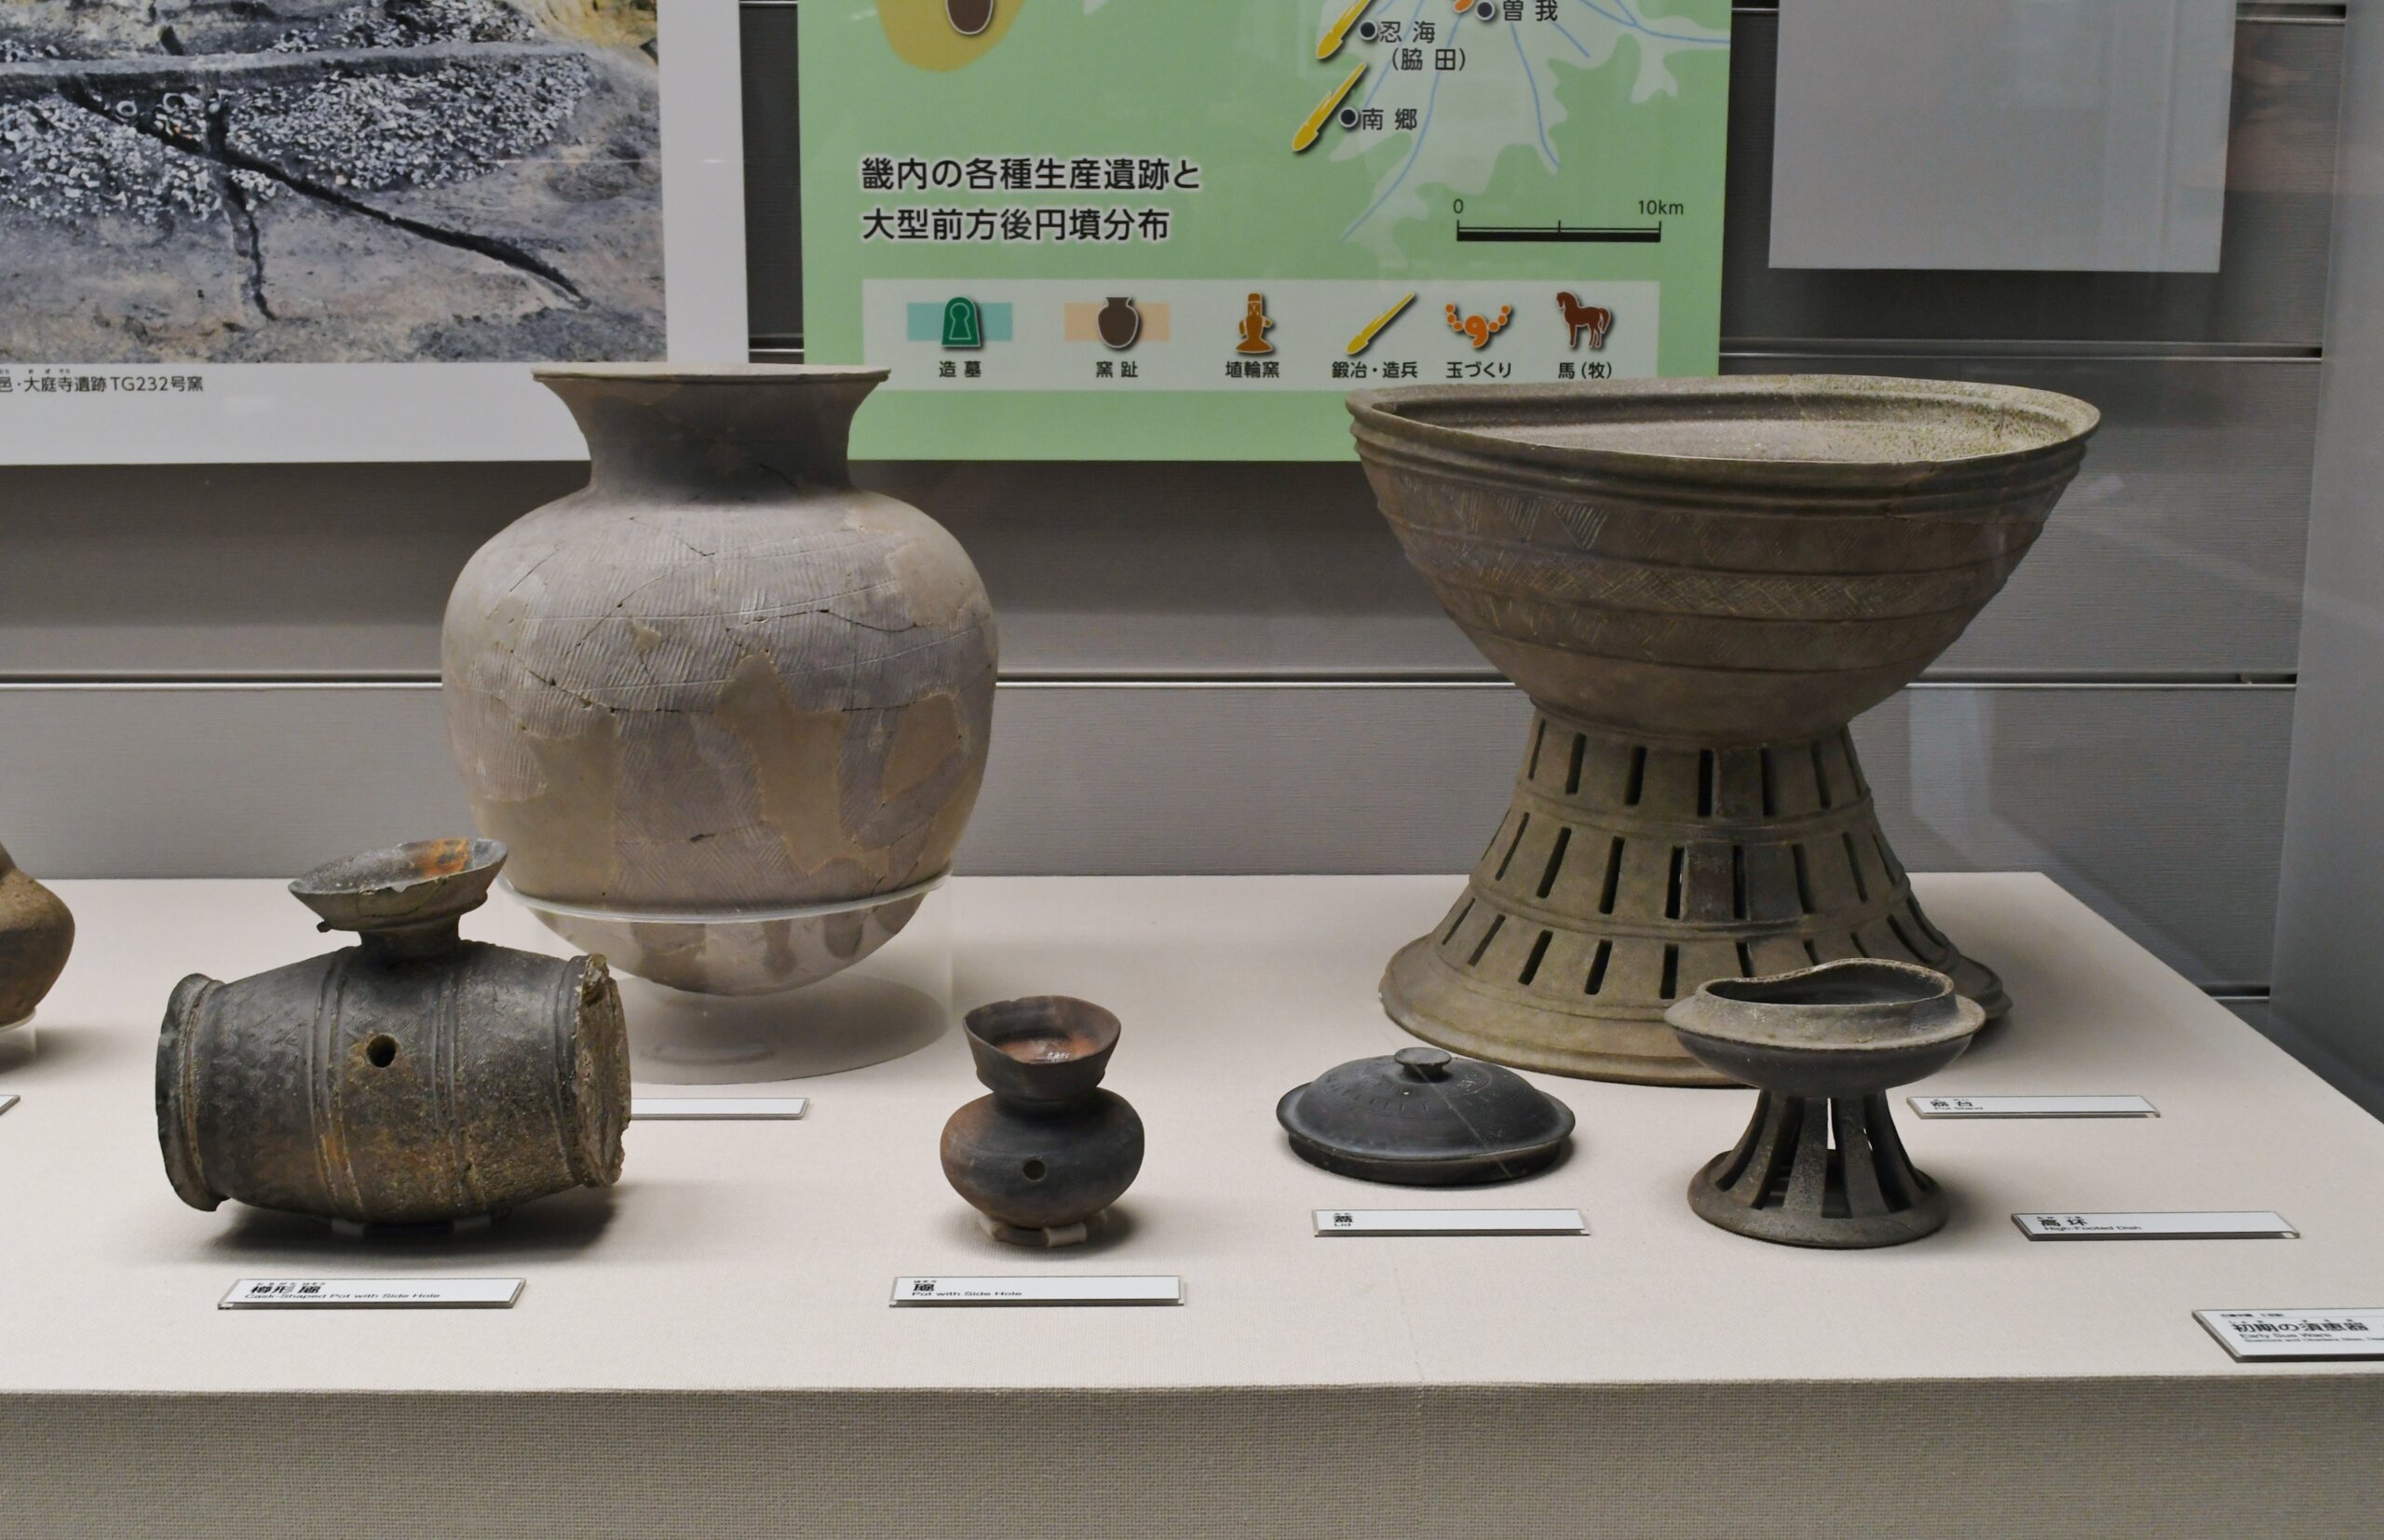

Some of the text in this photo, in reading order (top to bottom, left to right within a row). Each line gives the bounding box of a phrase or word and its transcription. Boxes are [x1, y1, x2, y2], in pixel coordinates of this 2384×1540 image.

[1379, 20, 1436, 44] 忍海
[1361, 108, 1418, 131] 南郷
[861, 156, 1200, 191] 畿内の各種生産遺跡と
[1453, 198, 1464, 215] 0
[1638, 199, 1684, 215] 10km
[861, 208, 1171, 241] 大型前方後円墳分布
[939, 360, 982, 378] 造墓
[1226, 360, 1280, 379] 埴輪窯
[1446, 361, 1512, 379] 玉づくり
